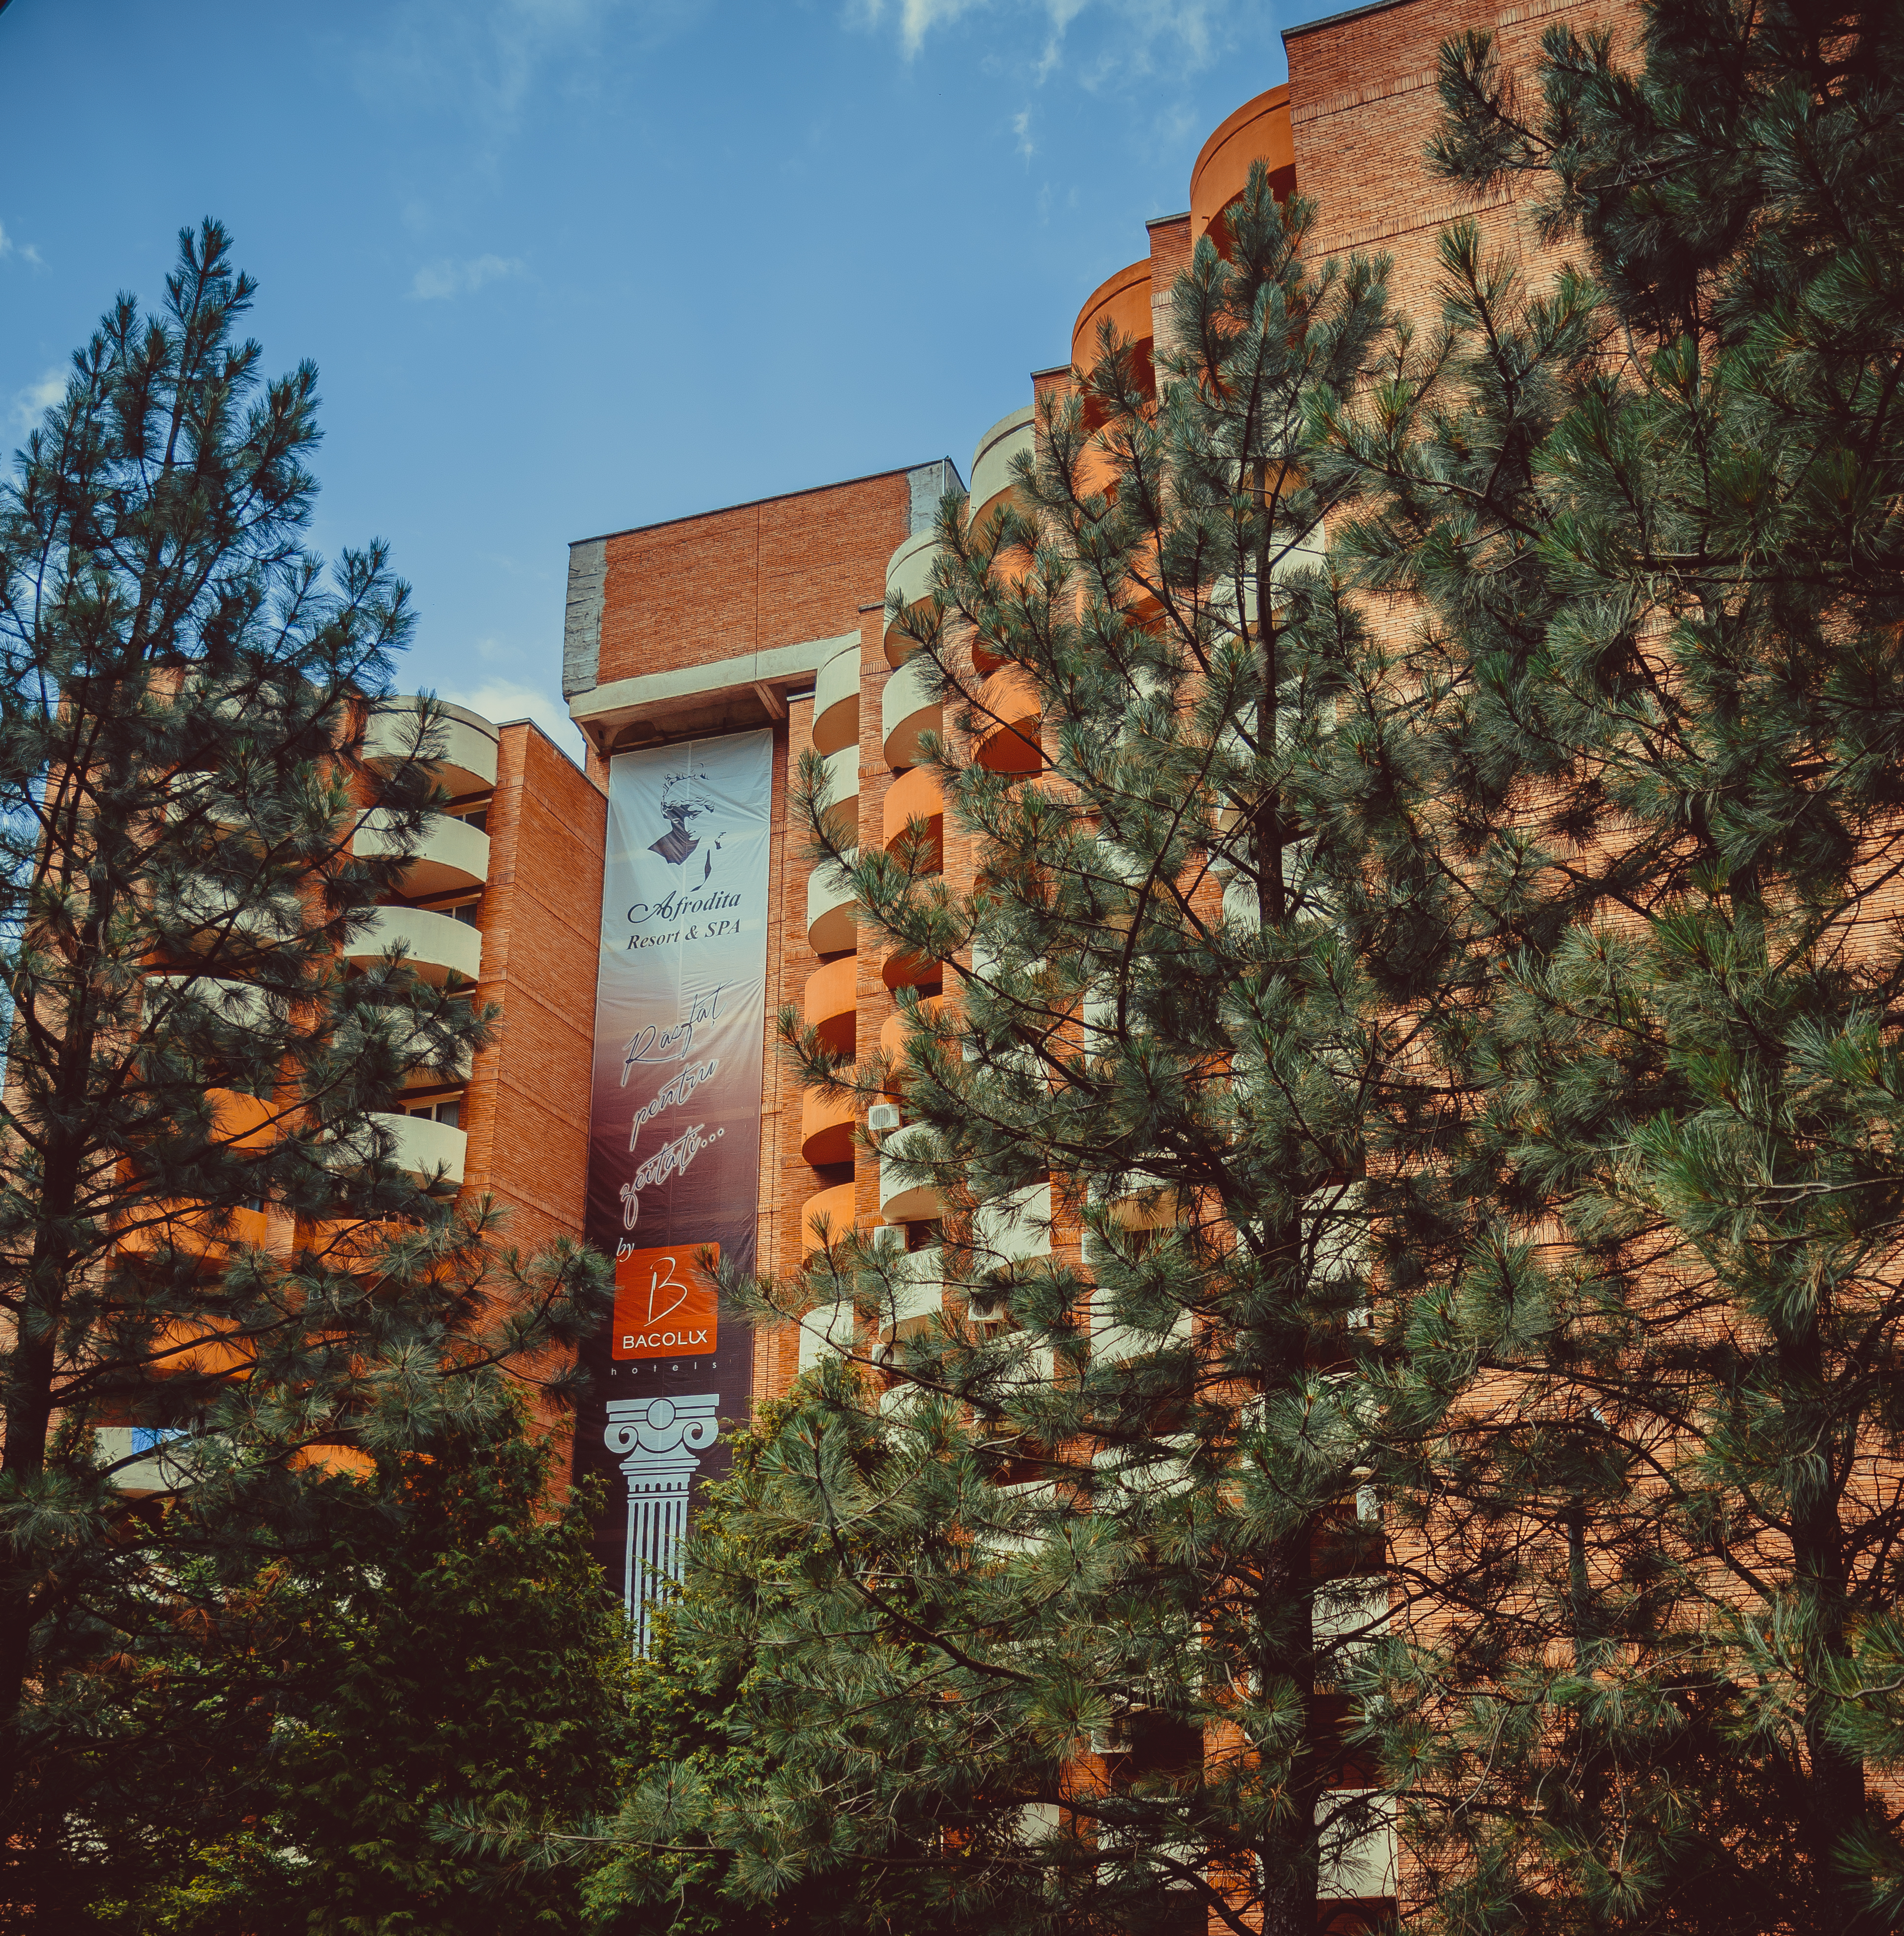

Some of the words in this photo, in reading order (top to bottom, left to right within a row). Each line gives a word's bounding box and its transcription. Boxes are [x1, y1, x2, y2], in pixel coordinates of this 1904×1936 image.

[627, 890, 742, 923] Afrodita
[626, 929, 680, 950] Resort
[684, 924, 698, 941] &
[704, 918, 742, 938] SPA
[629, 1060, 718, 1151] pentru
[616, 1237, 635, 1262] by
[643, 1257, 688, 1327] B
[623, 1329, 708, 1349] BACOLUX
[611, 1361, 717, 1376] hotels
